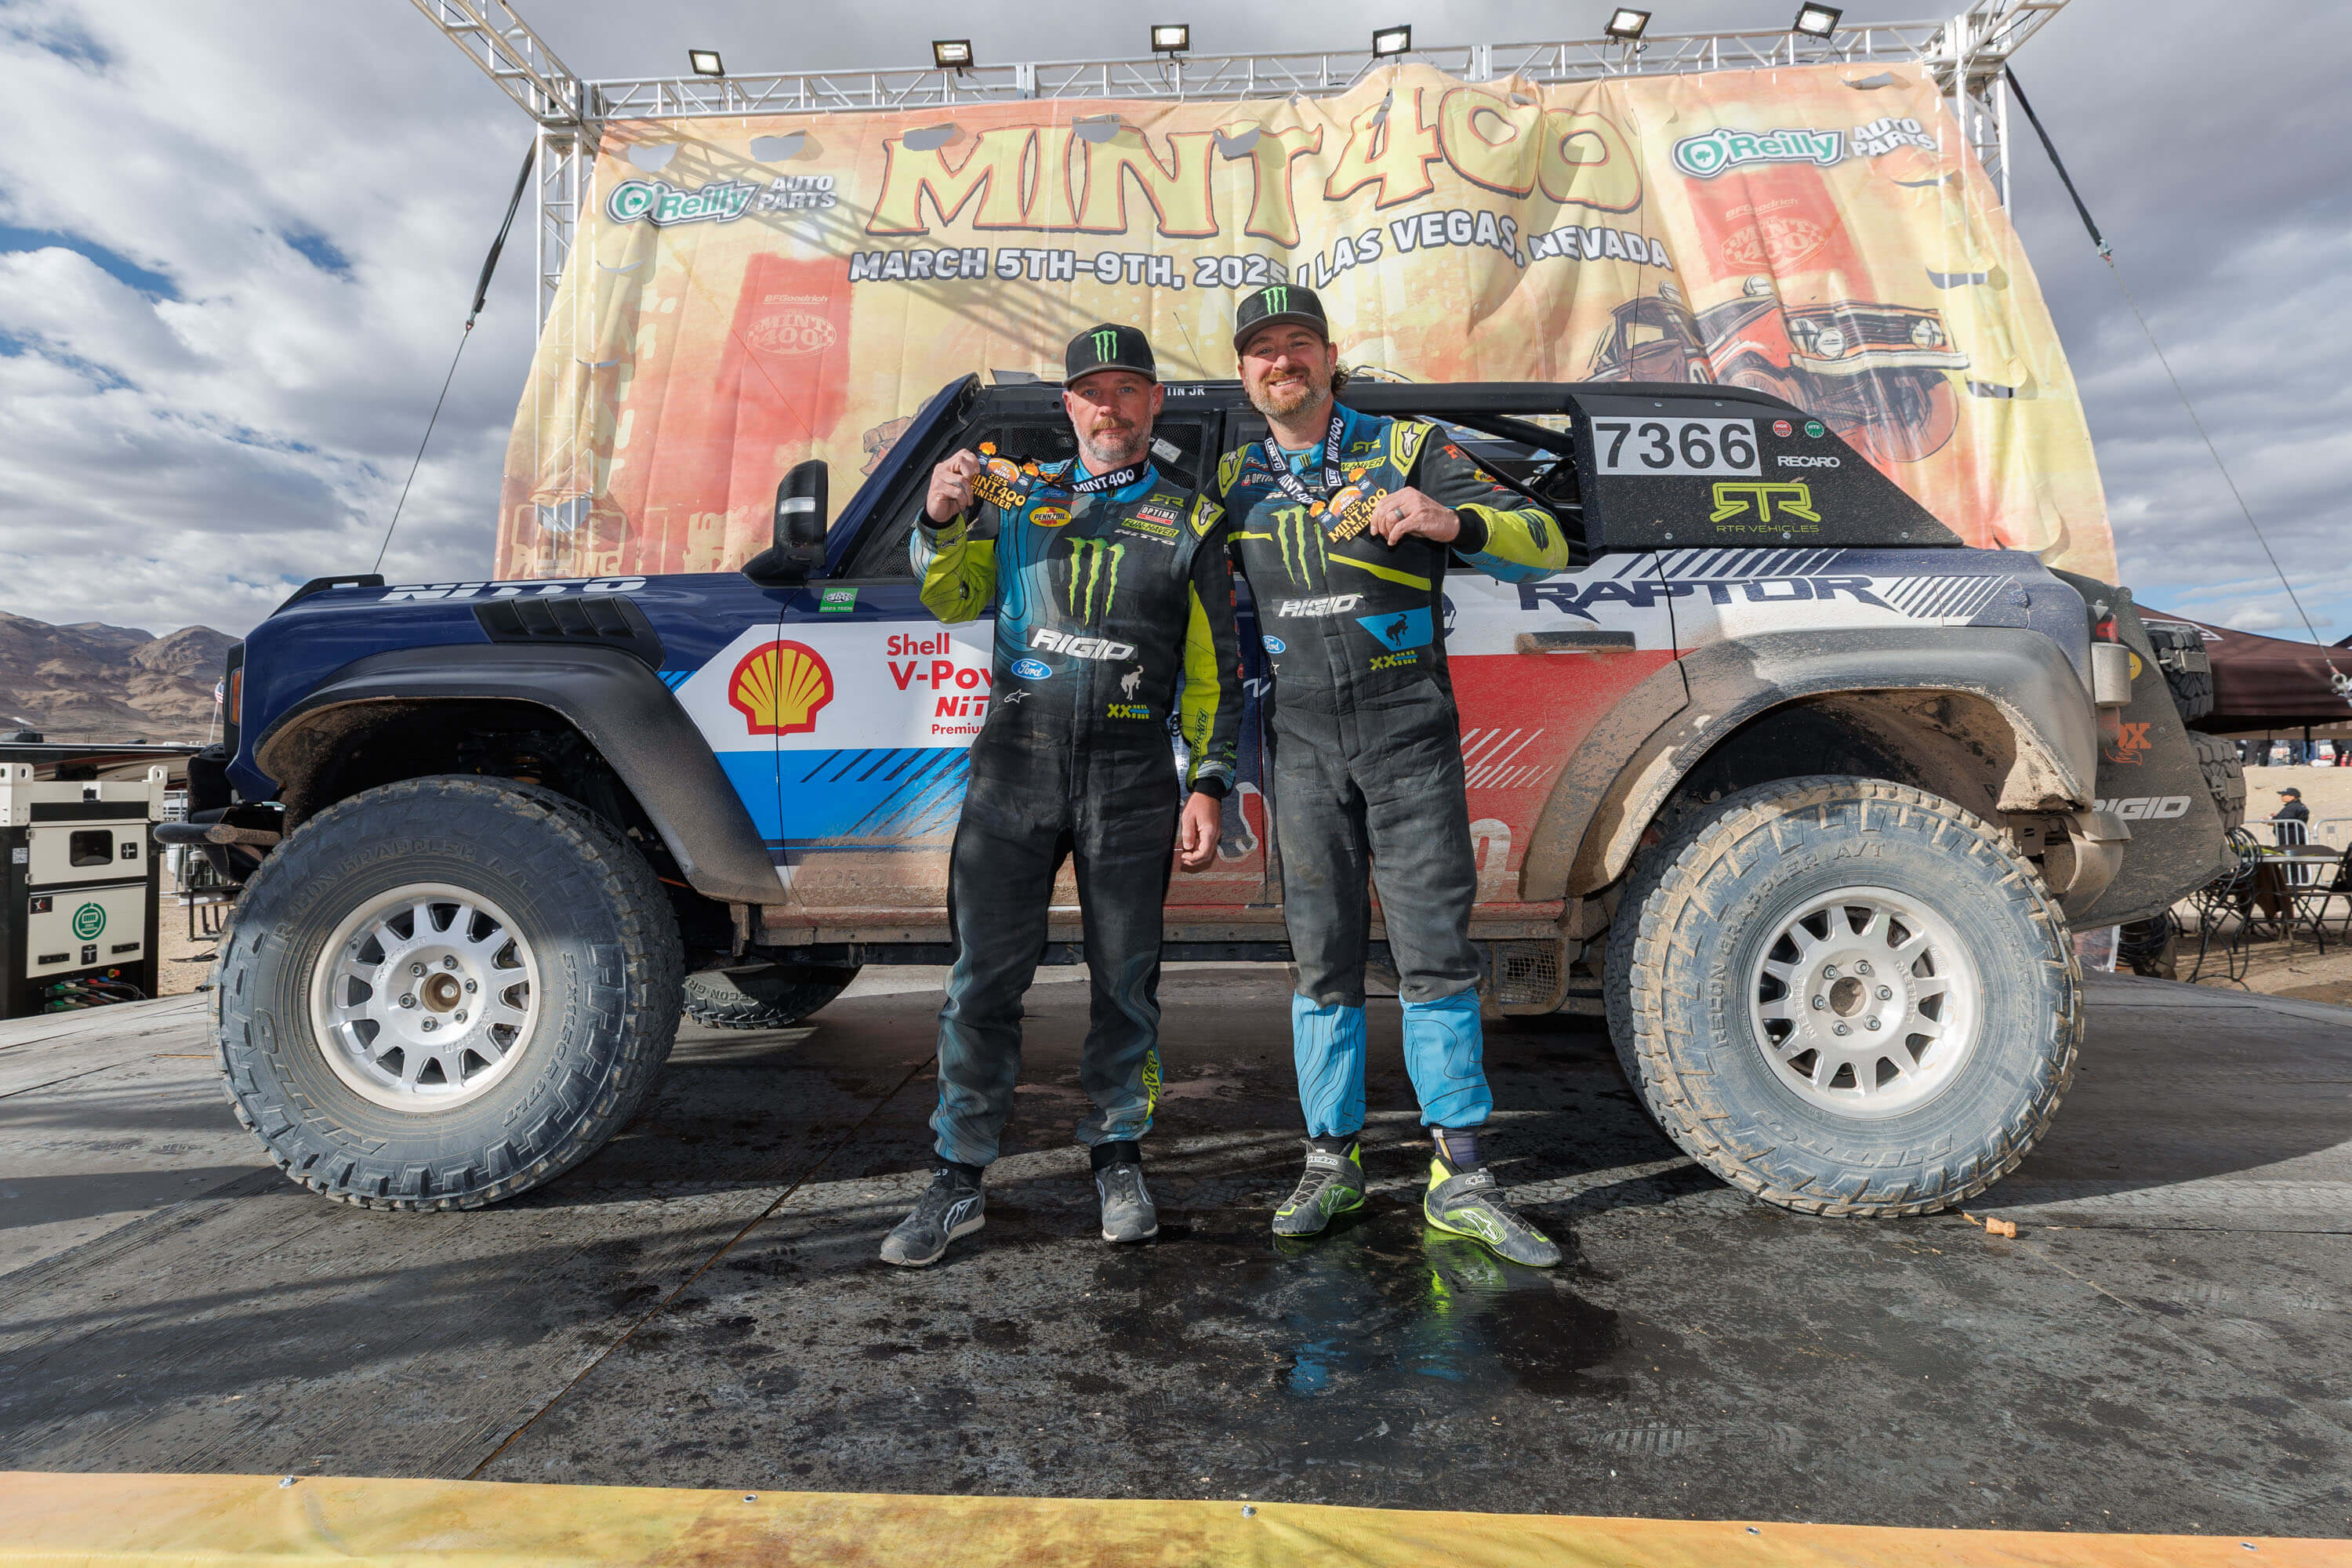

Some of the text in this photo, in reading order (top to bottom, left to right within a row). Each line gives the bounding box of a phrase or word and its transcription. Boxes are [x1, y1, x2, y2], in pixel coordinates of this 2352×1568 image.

[1855, 117, 1922, 141] AUTO
[1683, 132, 1836, 171] O'Reilly
[1849, 132, 1938, 158] PARTS
[866, 85, 1642, 249] MINT 400
[768, 176, 835, 193] AUTO
[615, 183, 750, 220] O'Reilly
[757, 191, 837, 211] PARTS
[1725, 198, 1800, 220] BFGoodrich
[848, 247, 988, 281] MARCH
[1193, 253, 1290, 289] 2025
[1315, 227, 1383, 289] LAS
[1390, 209, 1526, 268] VEGAS,
[1527, 224, 1675, 271] NEVADA
[757, 313, 828, 332] MINT
[758, 327, 819, 347] 400
[1188, 385, 1206, 397] JR
[1595, 423, 1757, 470] 7366
[1777, 456, 1840, 467] RECARO
[989, 474, 1009, 486] 2025
[1073, 470, 1135, 493] MINT 400
[971, 485, 1013, 511] FINISHER
[997, 487, 1027, 507] 400
[1033, 513, 1067, 521] PENNZOIL
[1142, 506, 1175, 520] OPTIMA
[1327, 488, 1388, 543] MINT 400
[1341, 500, 1362, 517] 2025
[1114, 528, 1176, 546] NITTO
[1123, 519, 1177, 536] FUN-HAVER
[1716, 524, 1820, 533] RTR VEHICLES
[378, 576, 648, 602] NITTO
[1517, 575, 1901, 624] RAPTOR
[1279, 593, 1359, 618] RIGID
[886, 633, 950, 656] Shell
[1031, 628, 1134, 660] RIGID
[1018, 661, 1043, 677] Ford
[931, 722, 983, 735] Premiu
